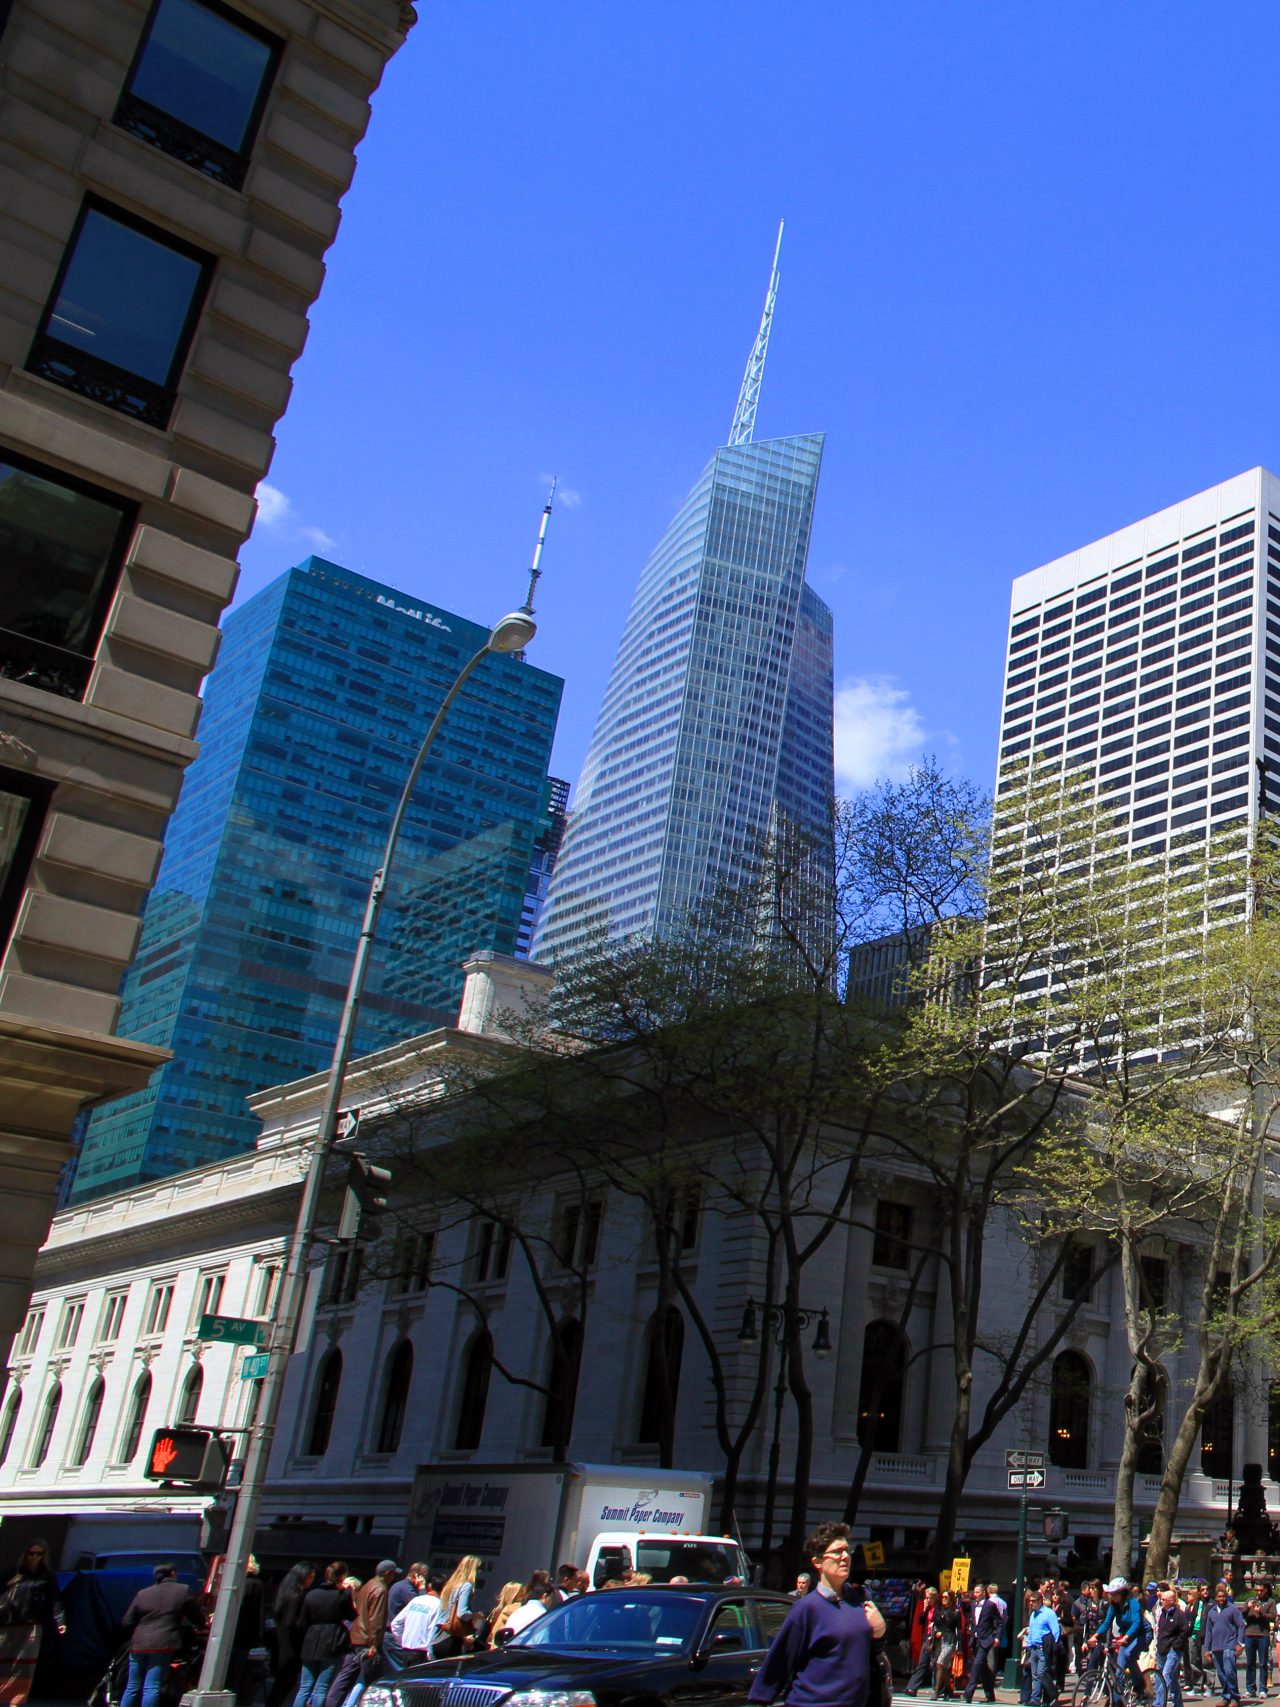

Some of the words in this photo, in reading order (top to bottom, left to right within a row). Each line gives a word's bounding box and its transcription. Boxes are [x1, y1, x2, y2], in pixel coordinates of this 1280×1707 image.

[210, 1319, 226, 1338] 5
[230, 1321, 246, 1332] AV
[250, 1357, 260, 1376] 40
[259, 1356, 268, 1367] ST
[1012, 1455, 1024, 1464] ONE
[1028, 1456, 1041, 1466] WAY
[1013, 1475, 1025, 1483] ONE
[1028, 1475, 1040, 1483] WAY
[600, 1505, 630, 1521] Summit
[629, 1506, 653, 1524] Paper
[652, 1508, 685, 1527] Company
[956, 1568, 962, 1581] 5
